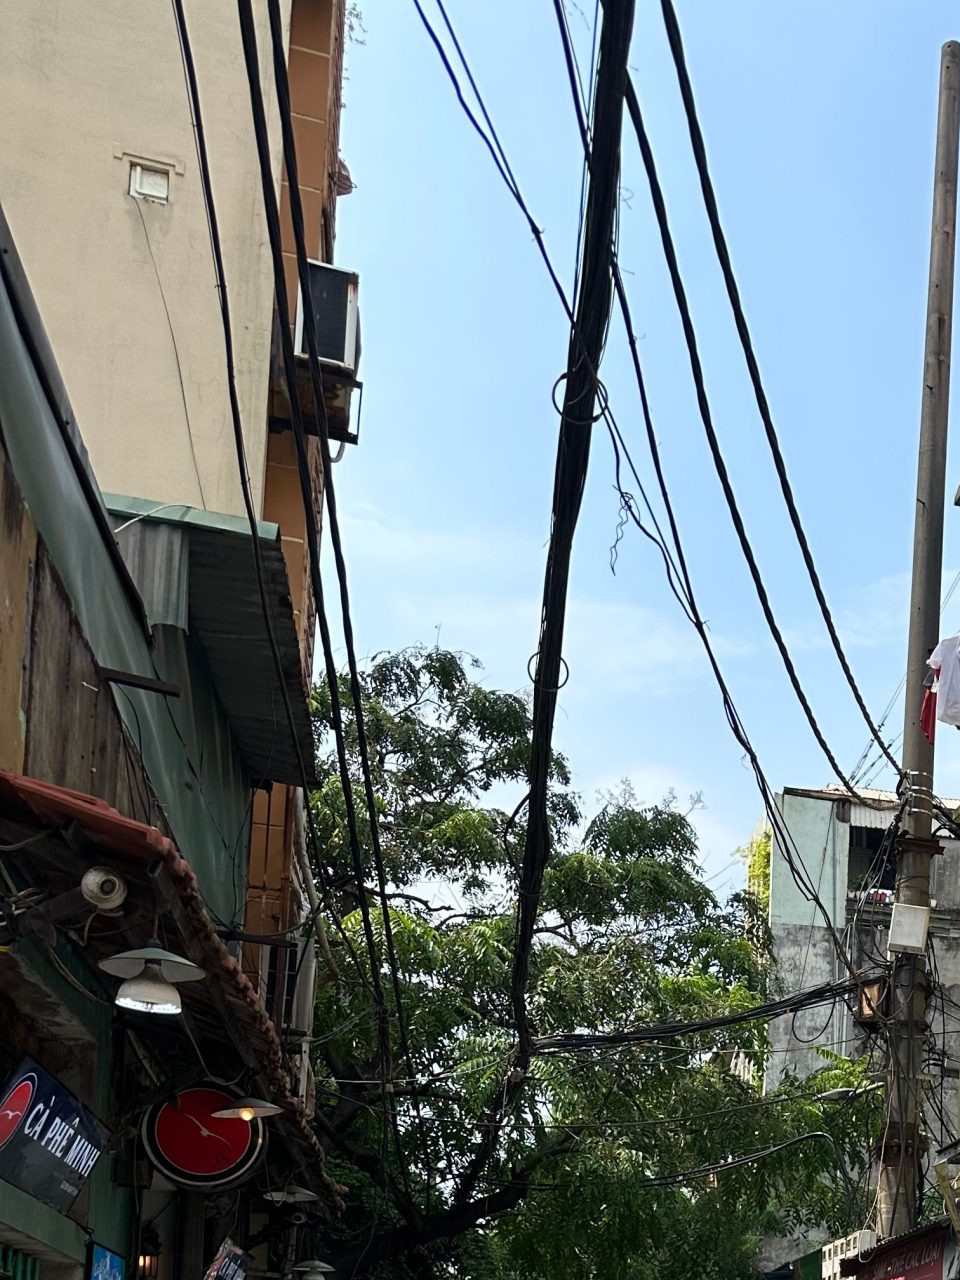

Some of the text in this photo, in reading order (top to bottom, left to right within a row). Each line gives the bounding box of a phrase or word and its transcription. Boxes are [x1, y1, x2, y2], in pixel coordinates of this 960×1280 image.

[24, 1095, 100, 1177] CÀ PHÊ MINH
